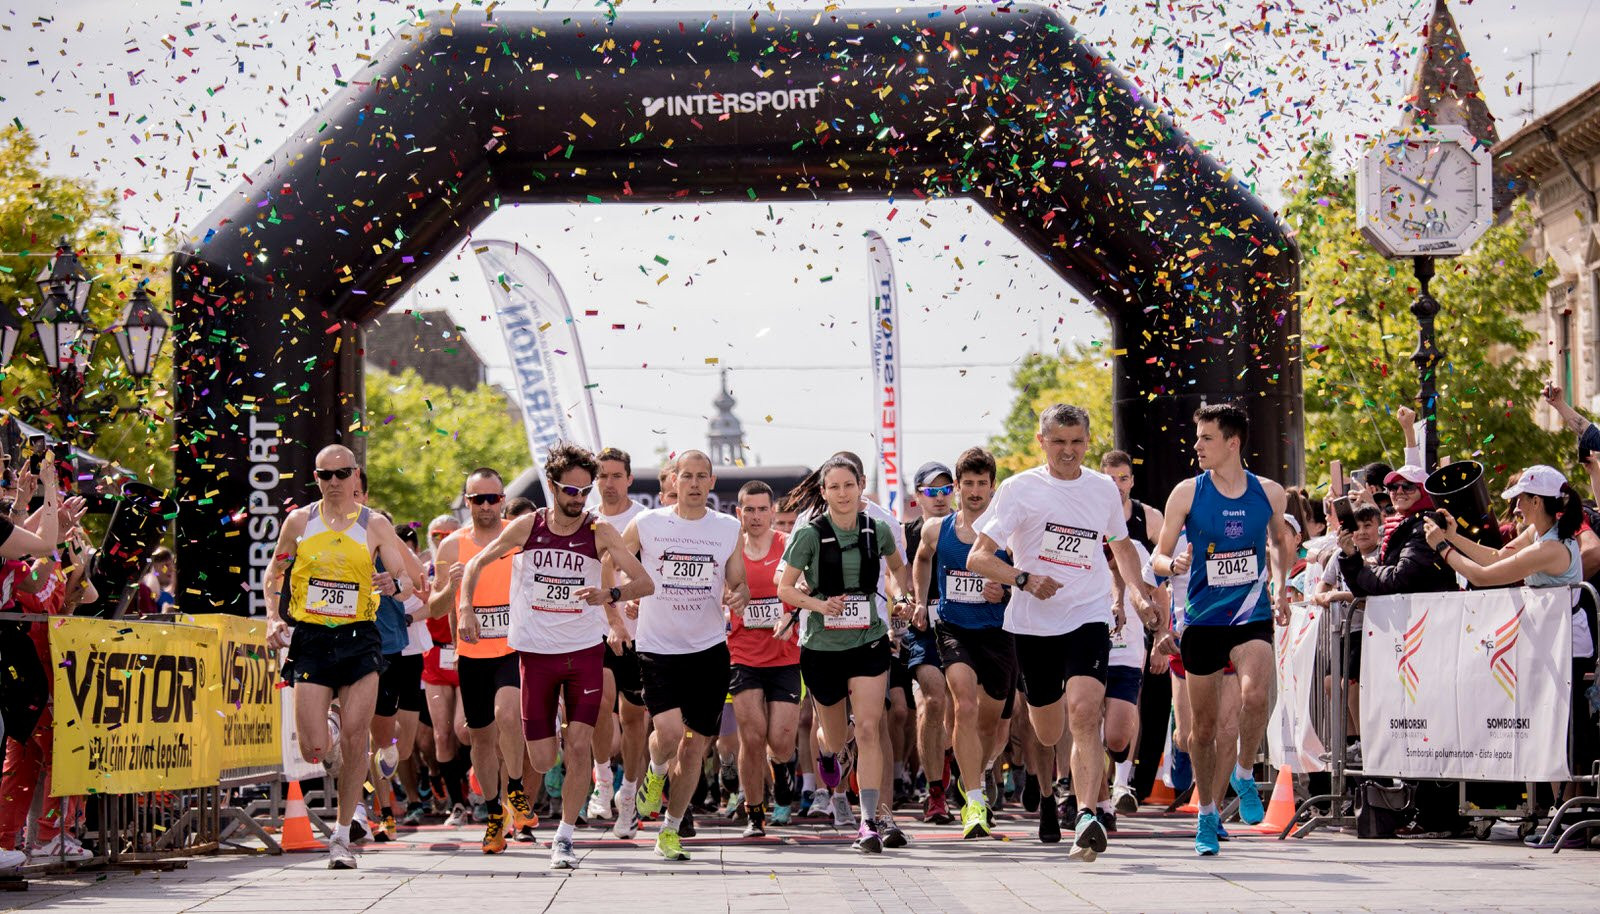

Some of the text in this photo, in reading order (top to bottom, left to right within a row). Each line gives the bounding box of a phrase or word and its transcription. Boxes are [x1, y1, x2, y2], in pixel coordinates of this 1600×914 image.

[667, 87, 822, 116] INTERSPORT
[248, 415, 281, 618] TERSPORT
[1057, 535, 1081, 553] 222
[533, 551, 585, 573] QATAR
[672, 562, 703, 577] 2307
[1217, 558, 1248, 575] 2042
[546, 585, 570, 600] 239
[955, 577, 983, 593] 2178
[320, 588, 345, 605] 236
[748, 605, 771, 619] 1012
[840, 603, 859, 617] 55
[482, 612, 509, 628] 2110
[1389, 718, 1428, 730] SOMBORSKI
[1486, 717, 1530, 730] SOMBORSKI
[129, 733, 154, 770] život
[1406, 747, 1434, 758] Somborski
[1434, 749, 1474, 760] polumaraton
[1479, 748, 1493, 759] čista
[1494, 749, 1513, 760] lepota
